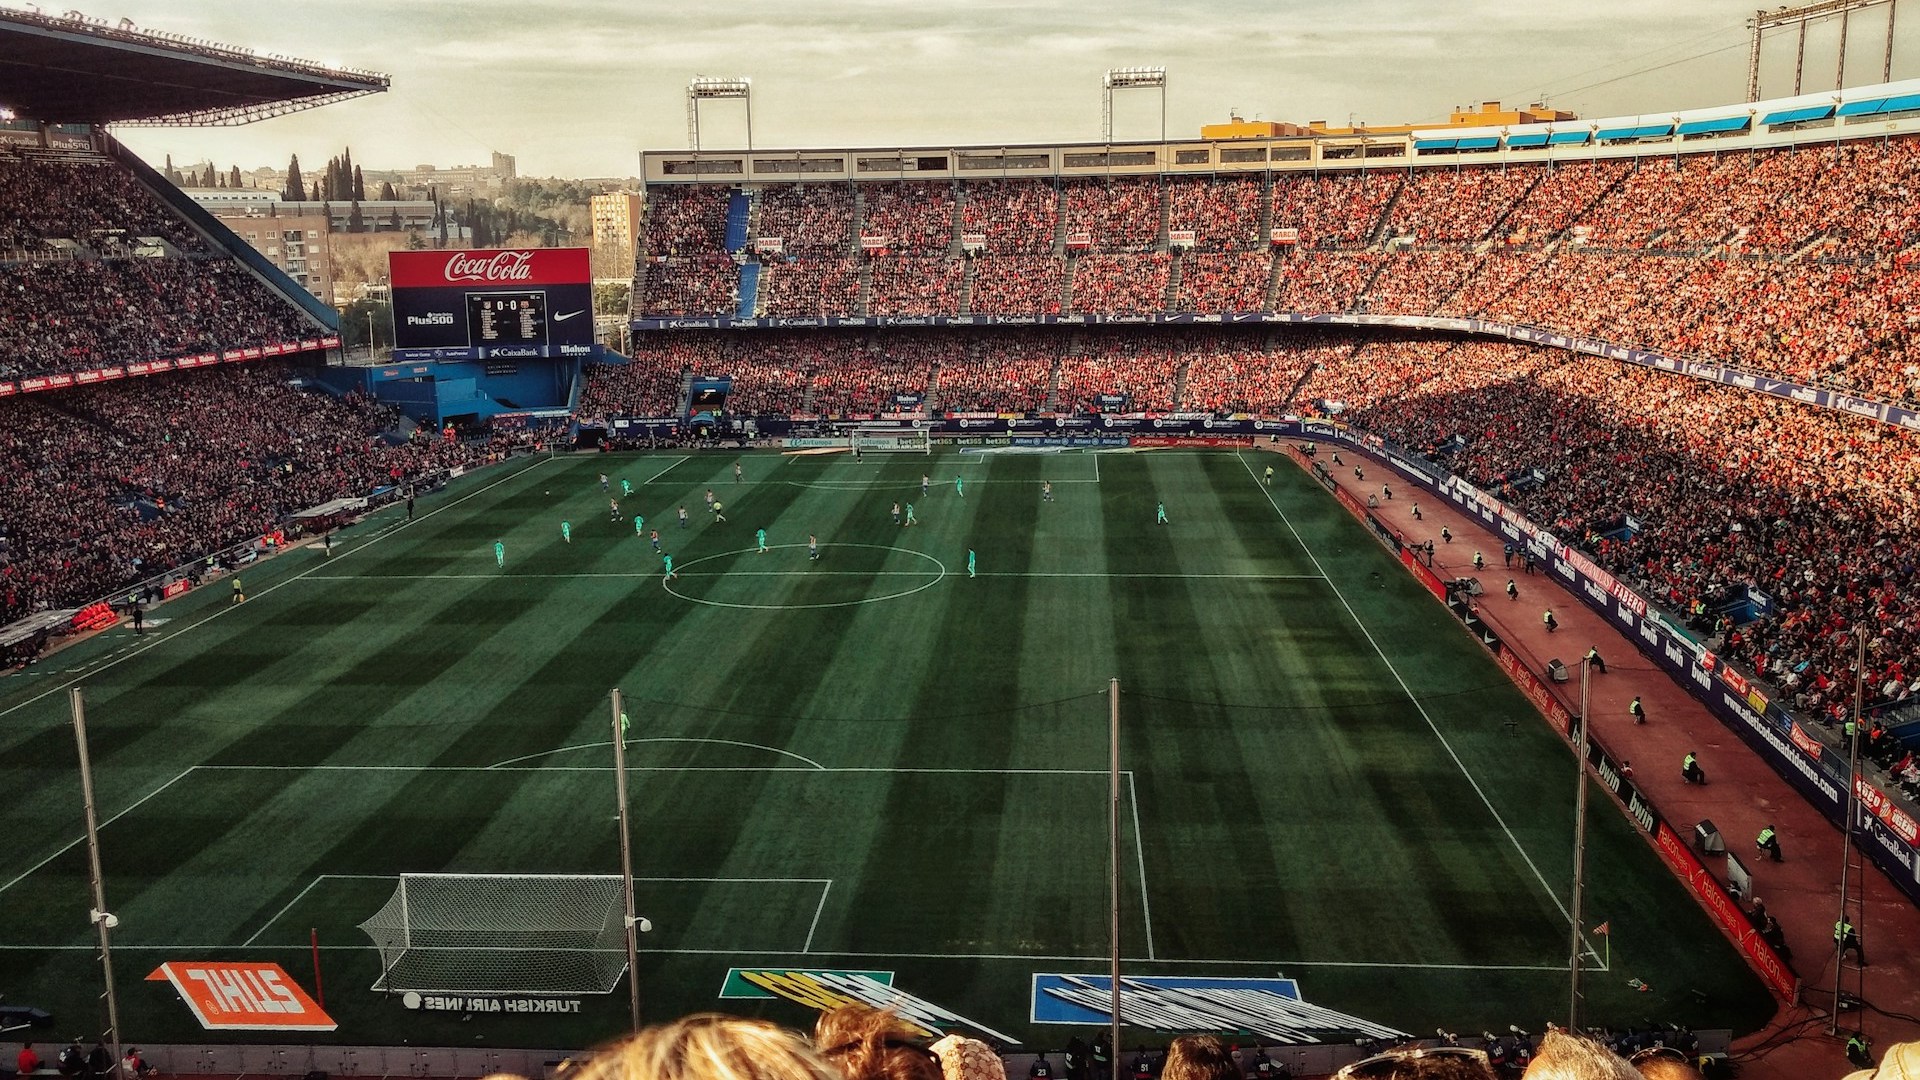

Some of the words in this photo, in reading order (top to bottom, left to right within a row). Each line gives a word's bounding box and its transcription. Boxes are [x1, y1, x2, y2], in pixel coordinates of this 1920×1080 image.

[52, 140, 90, 150] Plus500
[445, 251, 535, 281] Coca-Cola
[407, 315, 454, 326] Plus500
[678, 320, 710, 328] CaixaBank
[787, 318, 818, 326] CaixaBank
[895, 317, 926, 325] CaixaBank
[501, 348, 539, 357] CaixaBank
[560, 345, 591, 354] Mahou
[24, 377, 46, 388] Mahou
[78, 372, 99, 382] Mahou
[1618, 602, 1633, 627] bwin
[1640, 619, 1658, 647] bwin
[1665, 639, 1684, 668] bwin
[1691, 660, 1711, 691] bwin
[1723, 693, 1838, 804] www.atleticodemadridstore.com
[1599, 755, 1620, 794] bwin
[1629, 790, 1654, 832] bwin
[1874, 823, 1912, 871] CaixaBank
[186, 969, 305, 1014] STIHL
[1037, 1068, 1046, 1077] 23
[1140, 1063, 1148, 1072] 51
[1259, 1063, 1269, 1071] 107
